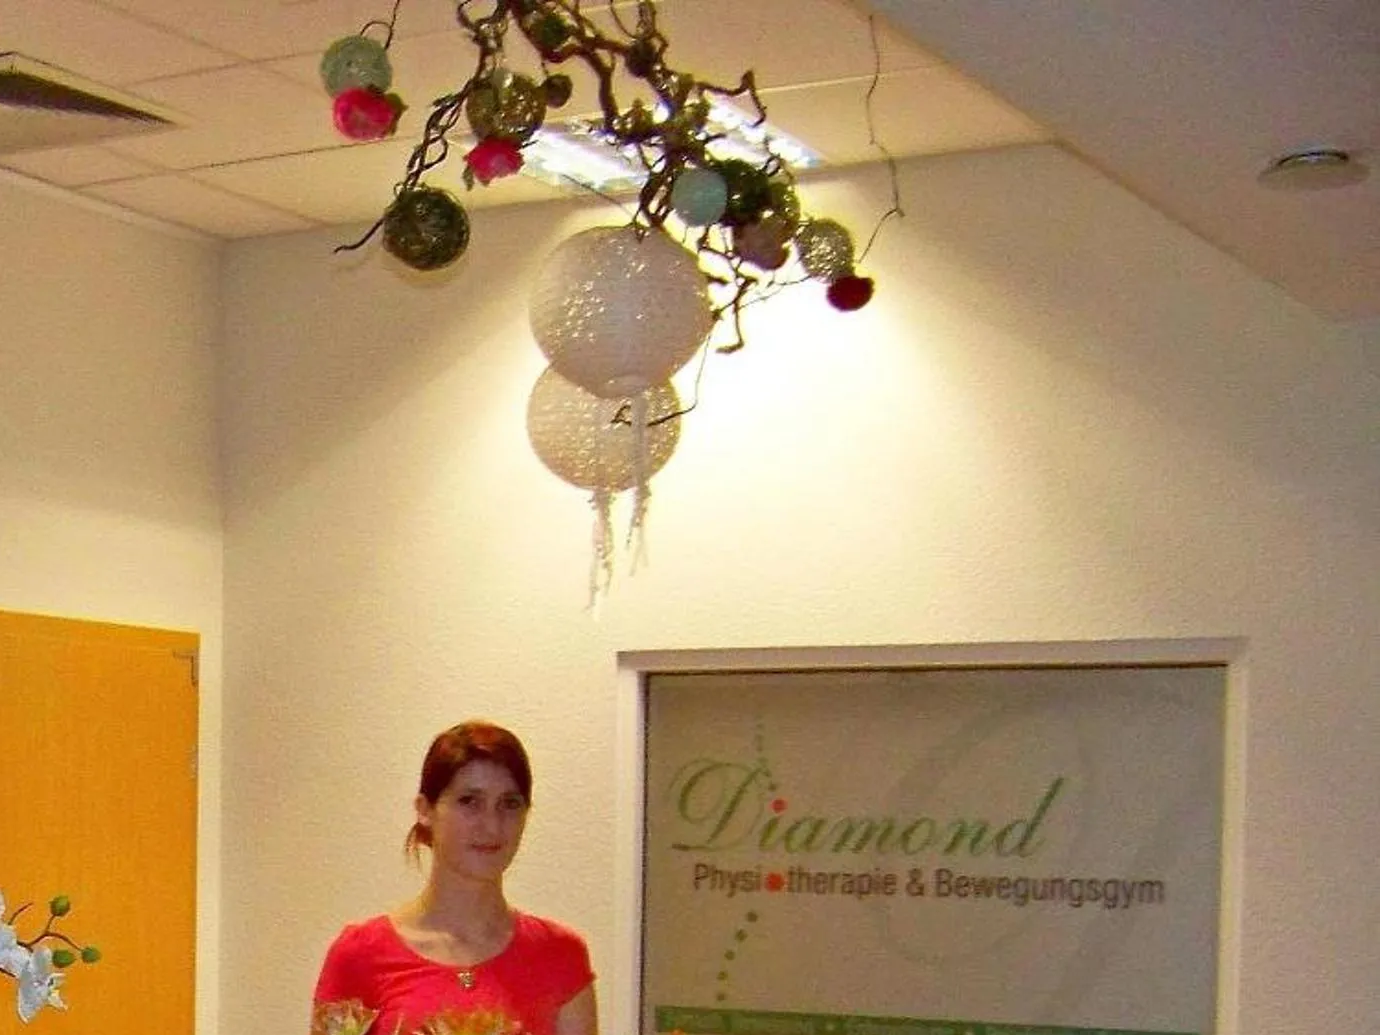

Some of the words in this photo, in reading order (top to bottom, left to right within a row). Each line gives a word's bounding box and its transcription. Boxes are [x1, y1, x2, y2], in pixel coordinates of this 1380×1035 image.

[668, 756, 1066, 859] Diamond
[905, 869, 925, 897] &
[935, 868, 1165, 911] Bewegungsgym
